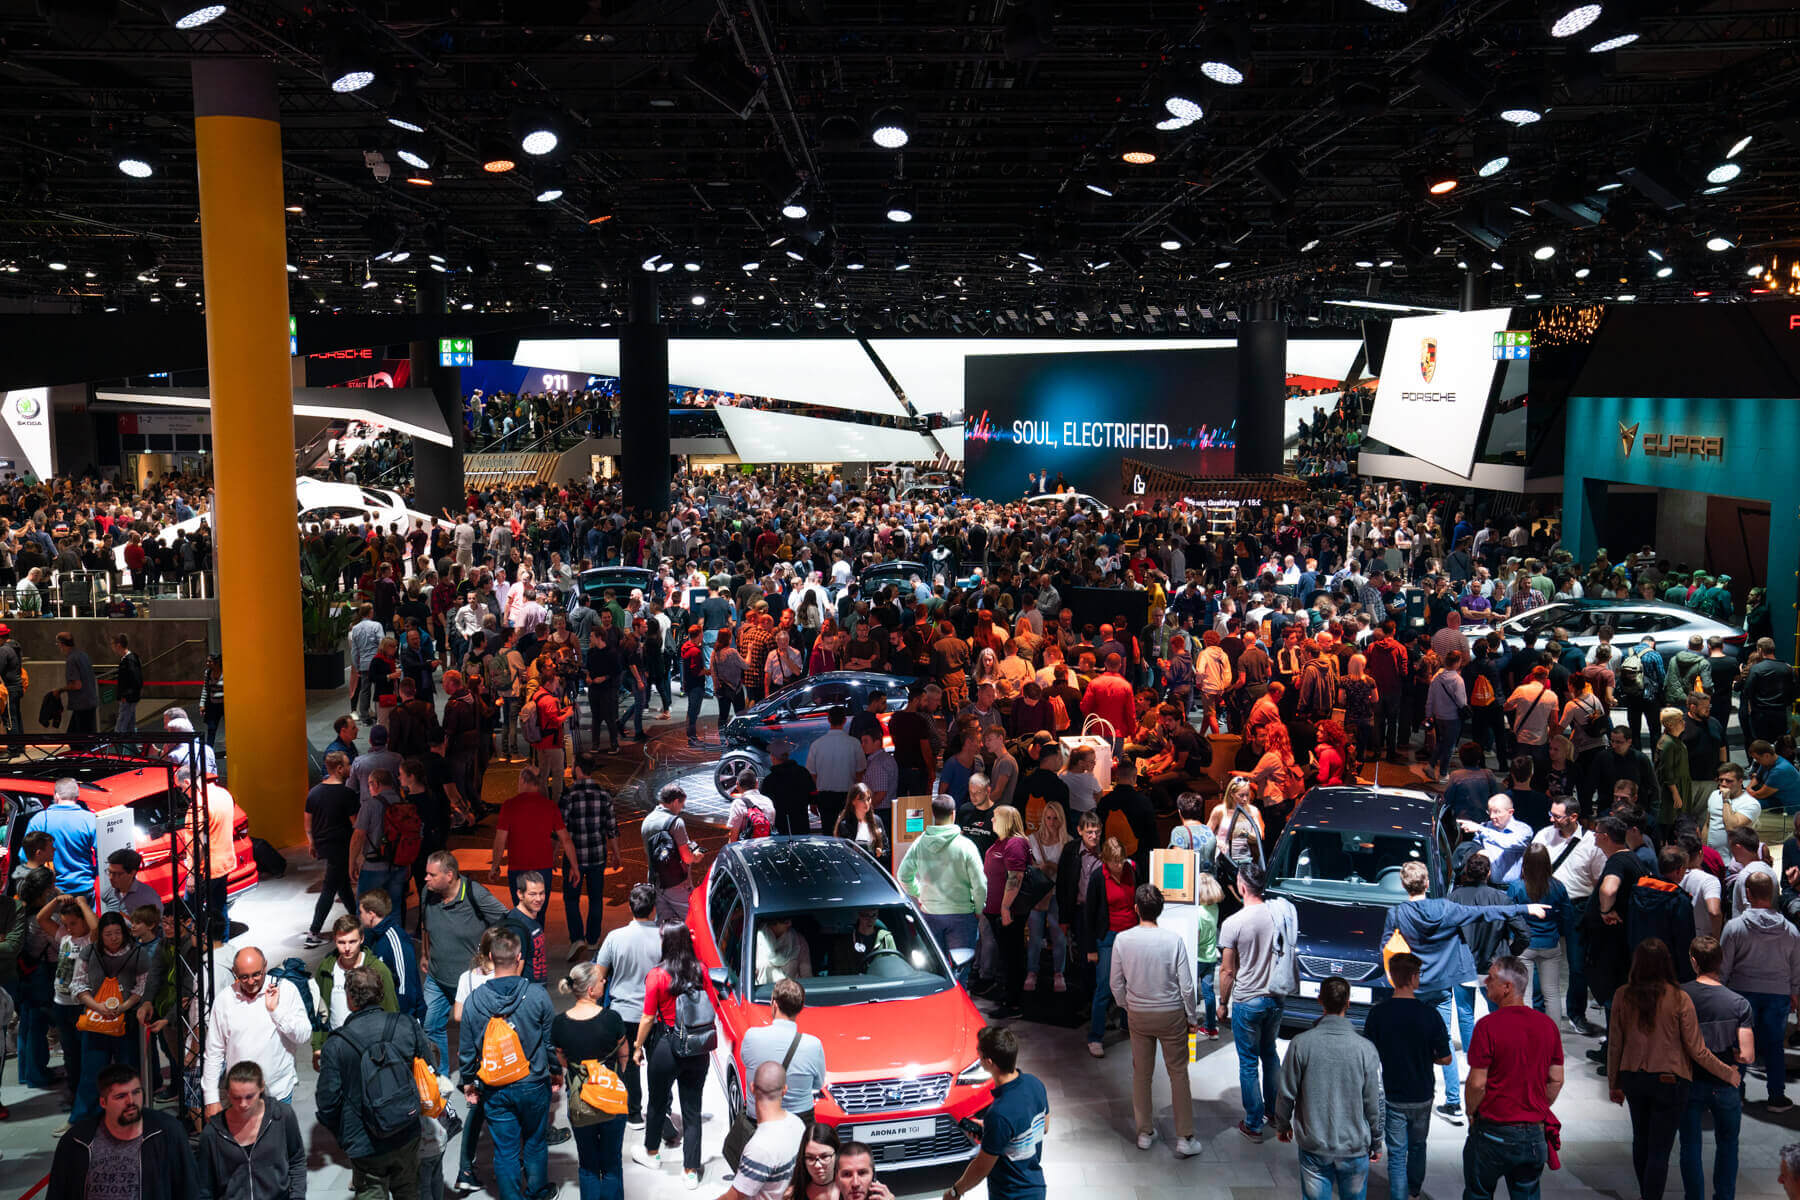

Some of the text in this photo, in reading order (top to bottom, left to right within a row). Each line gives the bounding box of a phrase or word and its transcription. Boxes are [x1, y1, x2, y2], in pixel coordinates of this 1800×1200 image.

[309, 349, 373, 359] PORSCHE
[542, 374, 568, 392] 911
[1401, 391, 1457, 402] PORSCHE
[1012, 420, 1173, 450] SOUL, ELECTRIFIED.
[1643, 433, 1723, 457] CUPRA
[870, 1129, 897, 1137] ARONA
